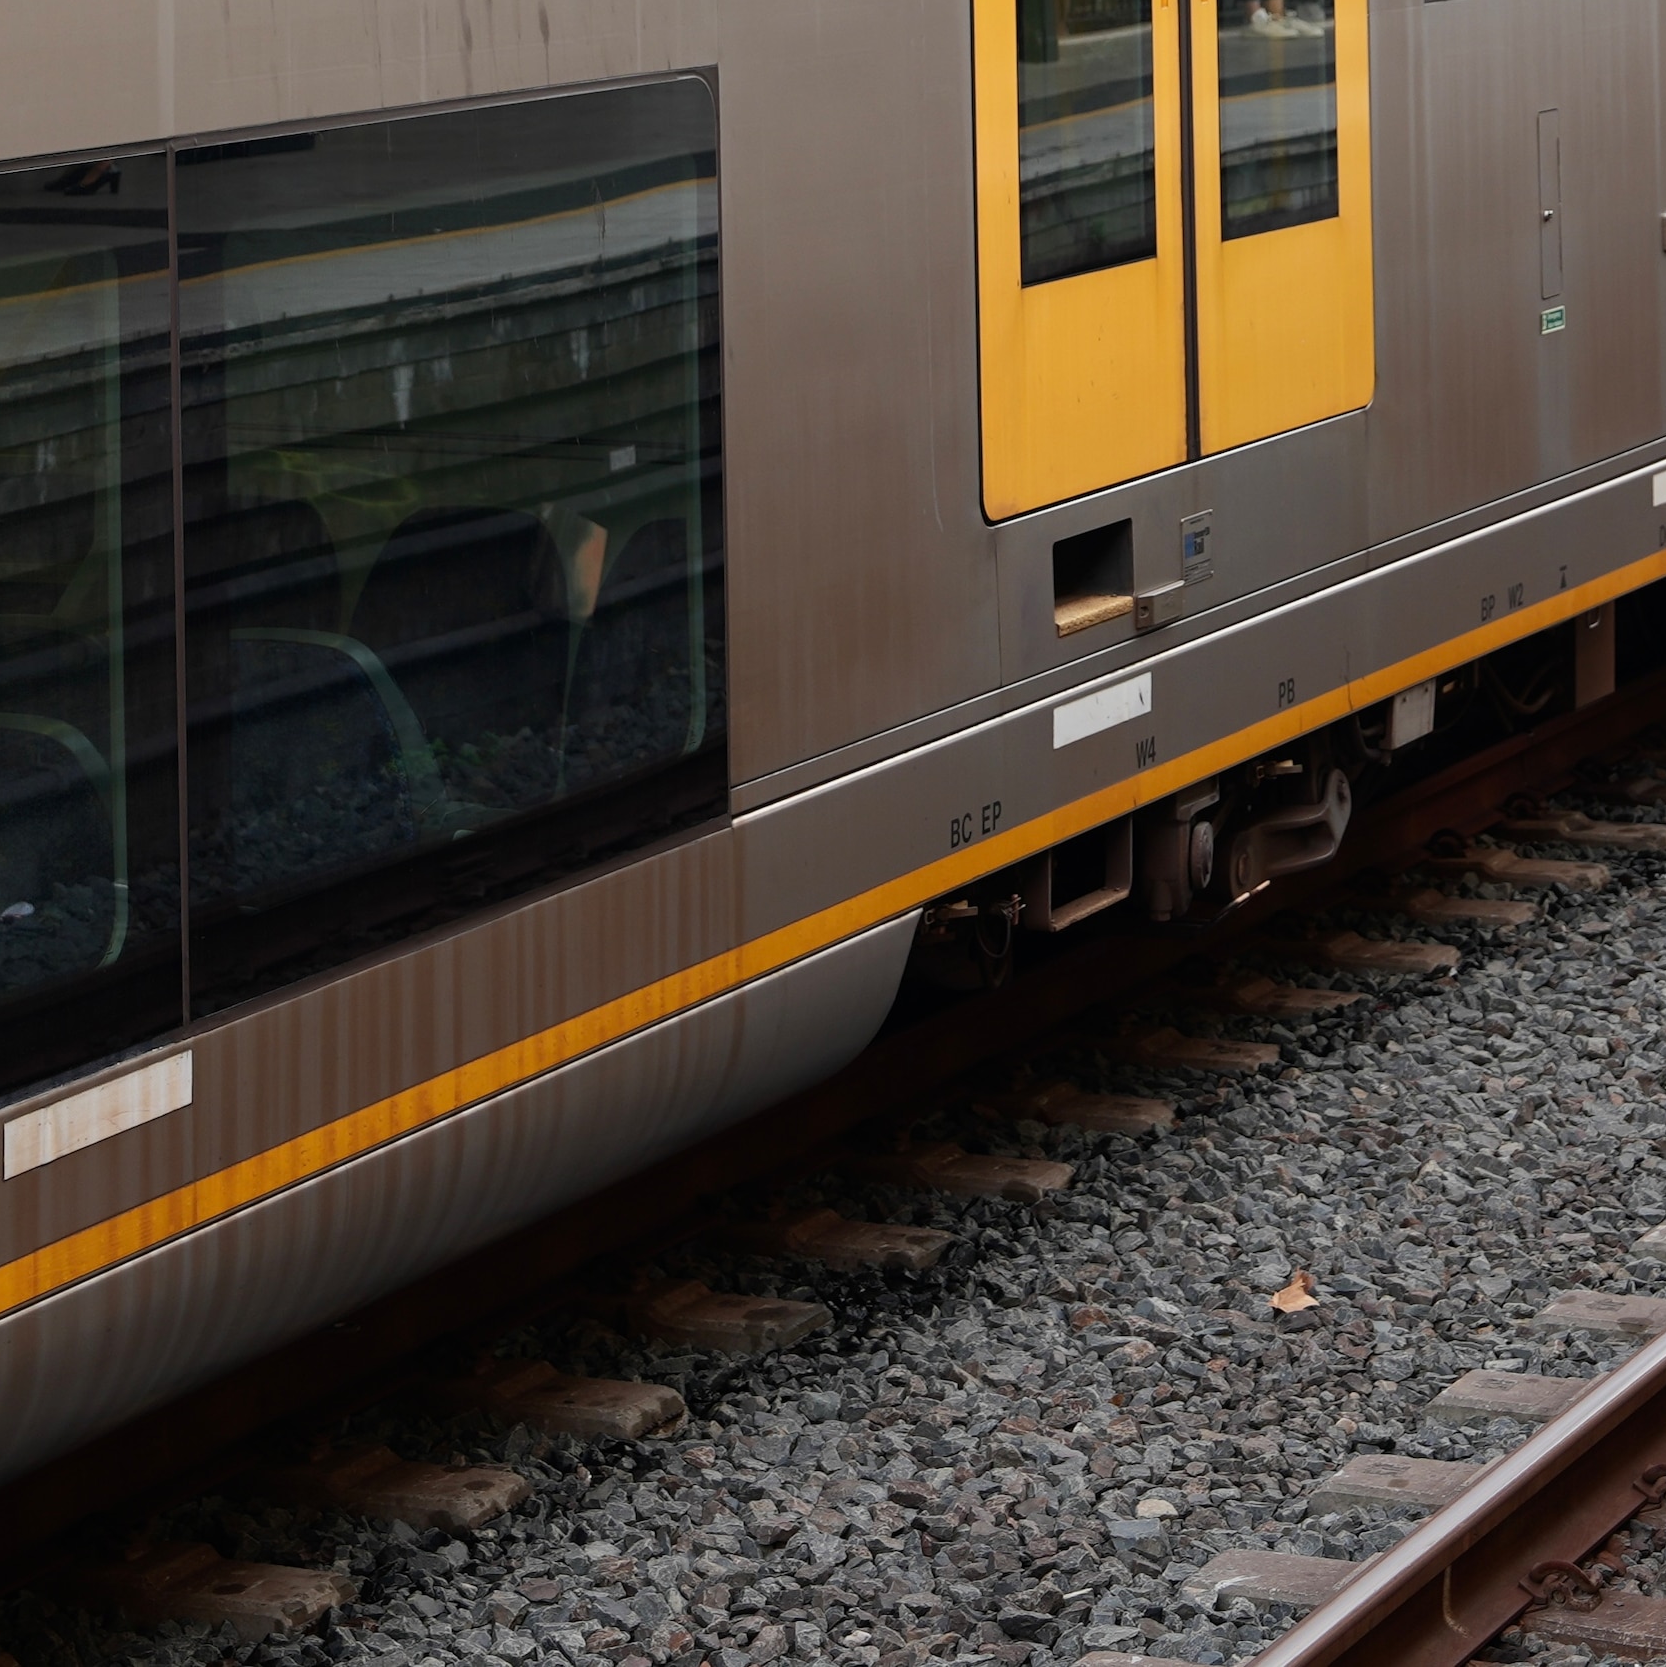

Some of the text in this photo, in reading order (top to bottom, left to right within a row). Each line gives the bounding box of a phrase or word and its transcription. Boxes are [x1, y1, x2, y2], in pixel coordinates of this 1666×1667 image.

[1481, 582, 1525, 622] BP W2
[1278, 677, 1296, 708] PB
[1136, 735, 1157, 770] W4
[950, 800, 1003, 849] BC EP
